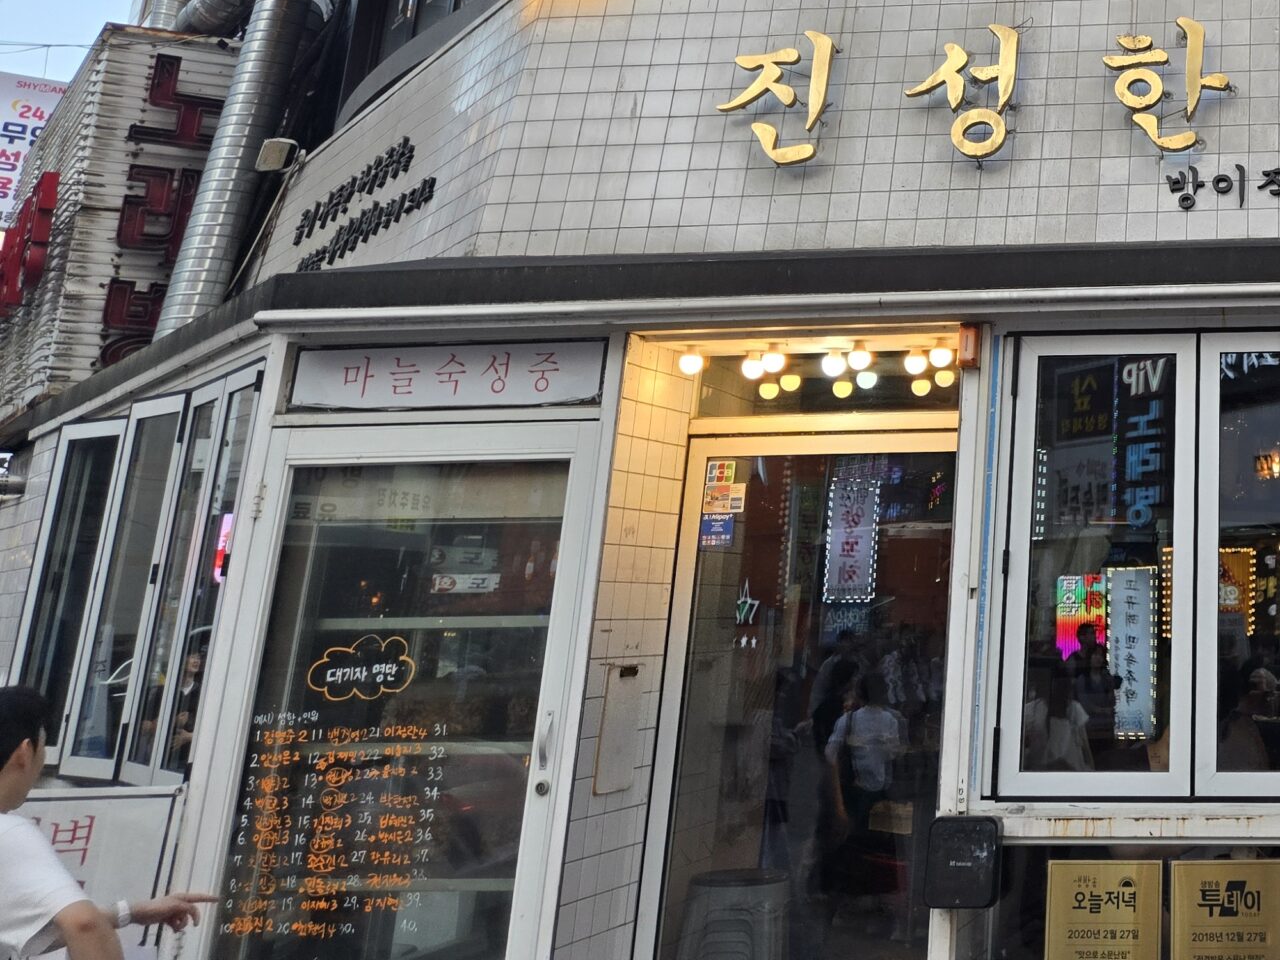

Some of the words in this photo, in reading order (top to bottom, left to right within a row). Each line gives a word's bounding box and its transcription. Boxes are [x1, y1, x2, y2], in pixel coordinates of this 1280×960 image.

[342, 350, 562, 398] 마늘숙성중
[708, 469, 733, 477] JCB
[326, 665, 367, 683] 대기자
[371, 662, 399, 683] 명단
[1072, 890, 1137, 914] 오늘저녁
[1067, 929, 1101, 941] 2020년
[1103, 928, 1118, 941] 2월
[1119, 928, 1140, 941] 27일
[1191, 931, 1224, 943] 2018년
[1225, 930, 1245, 943] 12월
[1246, 930, 1267, 943] 27일
